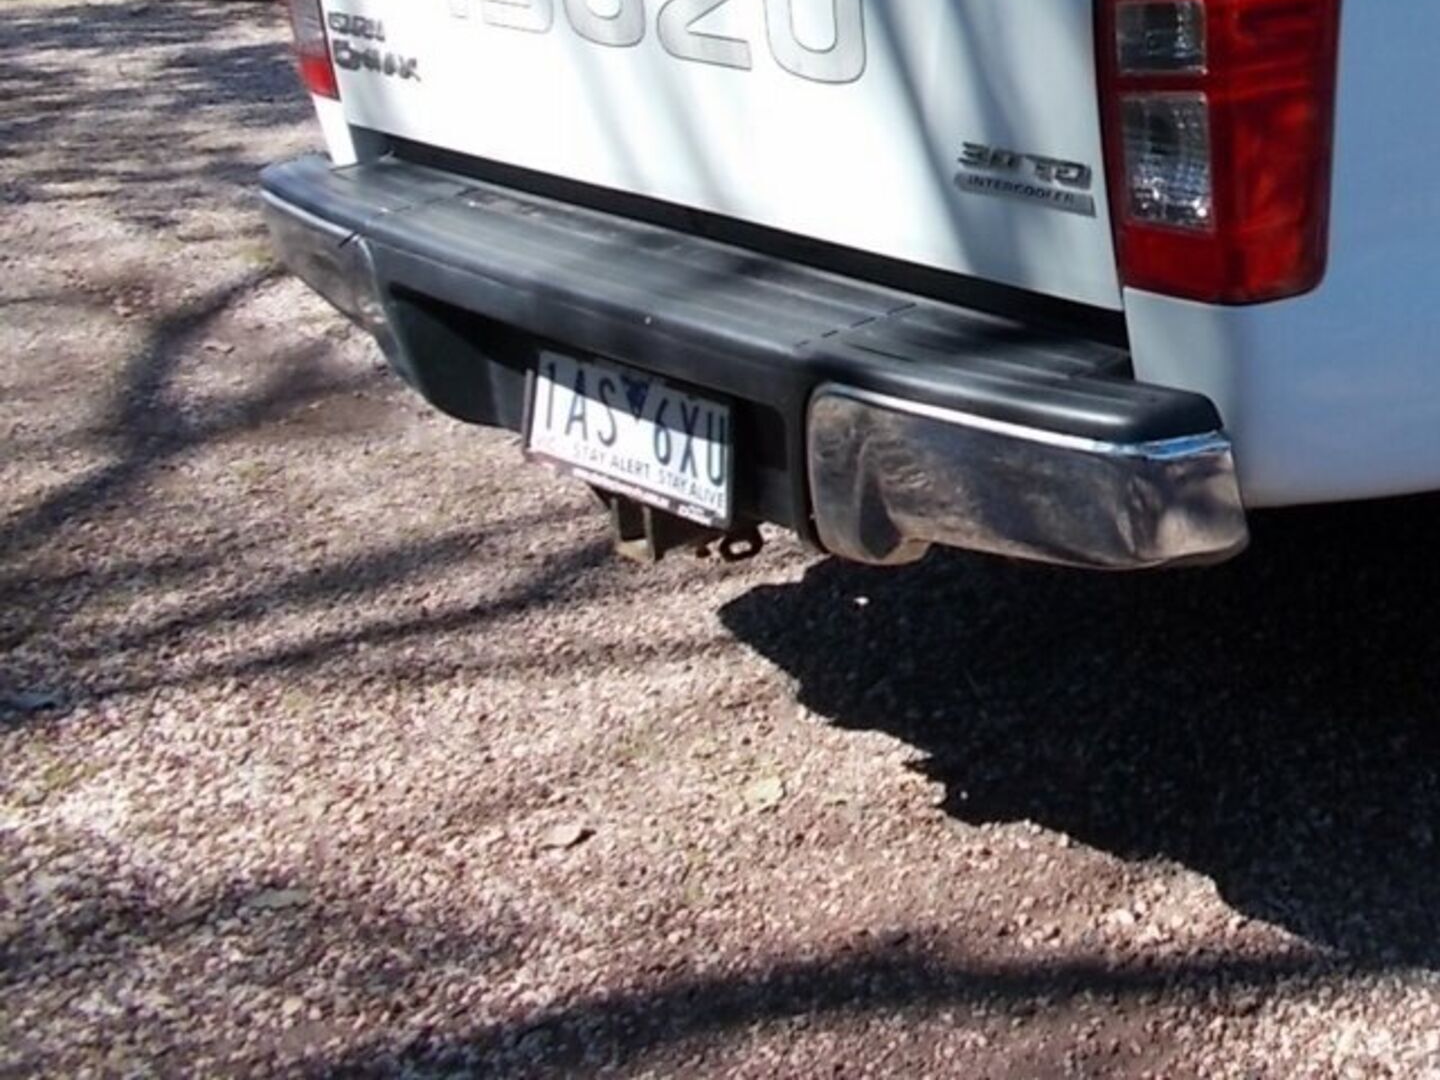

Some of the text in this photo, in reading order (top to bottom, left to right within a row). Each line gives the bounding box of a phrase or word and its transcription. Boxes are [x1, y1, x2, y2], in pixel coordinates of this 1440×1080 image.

[966, 174, 1076, 205] INTERCOOLER
[653, 398, 725, 487] 6XU
[573, 443, 606, 464] STAY
[610, 456, 651, 478] ALERT
[658, 469, 689, 493] STAY
[689, 481, 725, 507] ALIVE
